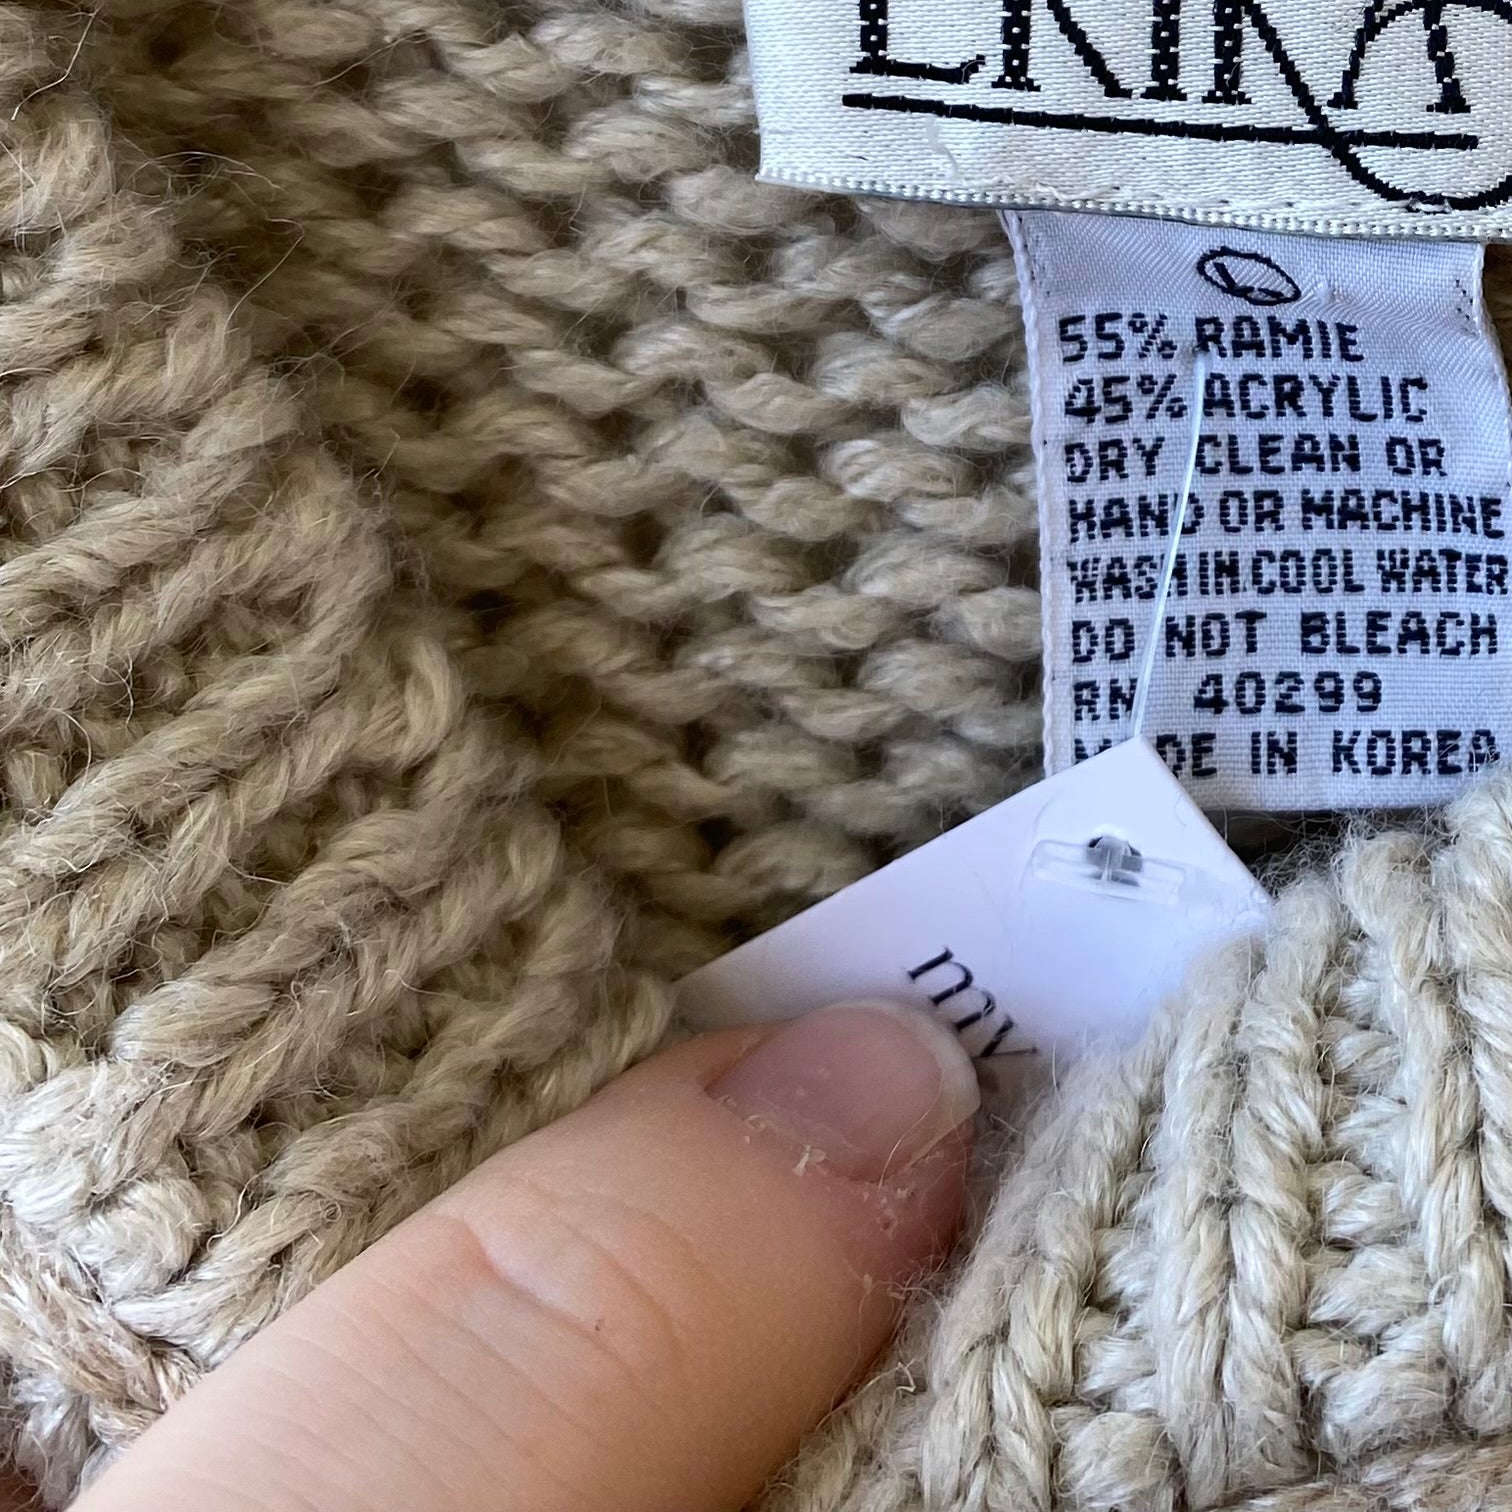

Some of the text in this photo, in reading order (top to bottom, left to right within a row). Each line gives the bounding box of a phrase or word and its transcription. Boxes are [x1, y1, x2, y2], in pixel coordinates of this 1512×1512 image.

[1058, 312, 1365, 362] 55% RAMIE
[1063, 372, 1428, 424] 45% ACRYLIC
[1064, 434, 1447, 483] DRY CLEAN OR
[1069, 489, 1505, 542] HAND OR MACHINE
[1199, 550, 1240, 596] IN
[1252, 548, 1366, 595] COOL
[1377, 548, 1509, 596] WATER
[1071, 609, 1499, 663] DO NOT BLEACH
[1074, 671, 1383, 721] RN 40299
[1074, 729, 1500, 779] MDE IN KOREA
